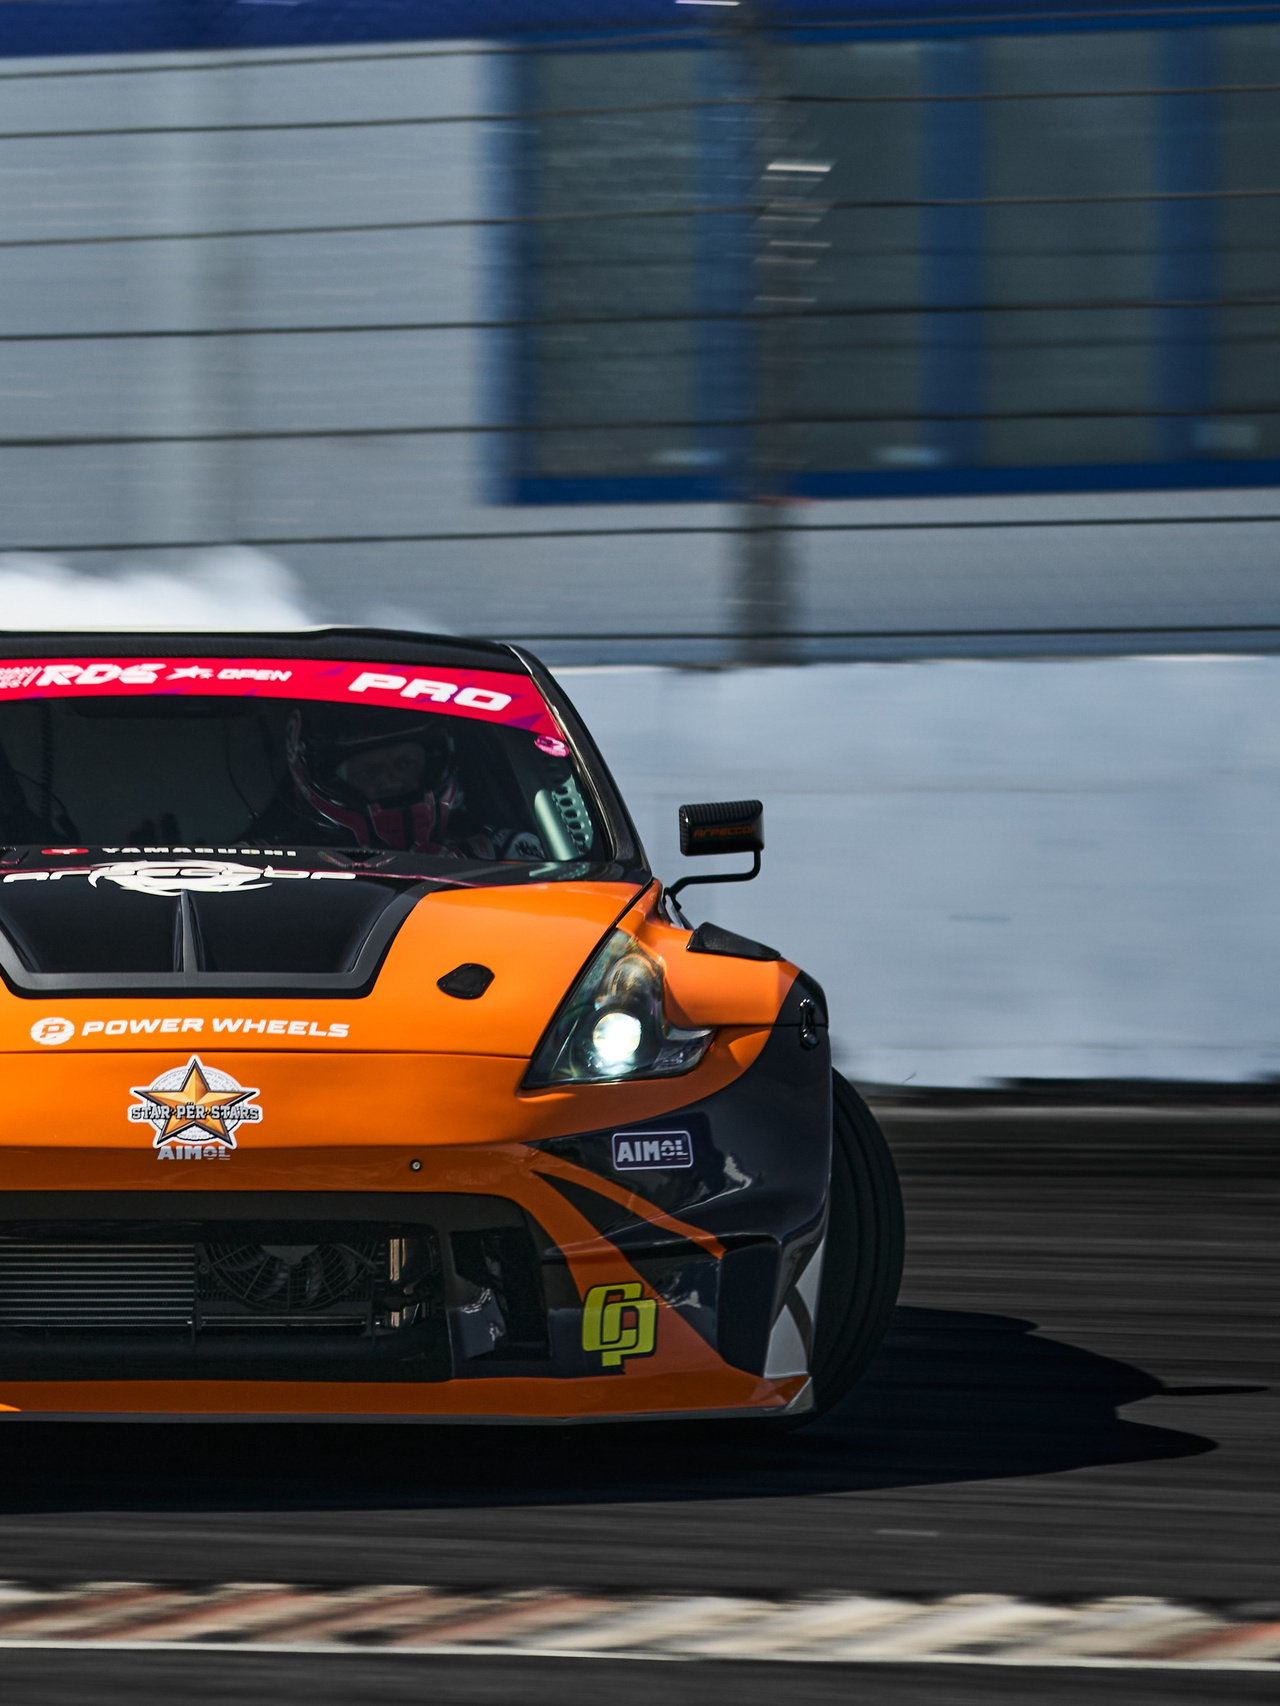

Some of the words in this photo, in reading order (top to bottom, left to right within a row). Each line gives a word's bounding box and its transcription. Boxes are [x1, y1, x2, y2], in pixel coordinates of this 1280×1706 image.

[35, 663, 167, 687] RDS
[216, 668, 293, 682] OPEN
[347, 671, 512, 712] PRO
[81, 1018, 204, 1036] POWER
[212, 1018, 350, 1038] WHEELS
[131, 1105, 171, 1119] STAR
[211, 1105, 260, 1120] STARS
[157, 1145, 231, 1160] AIMOL
